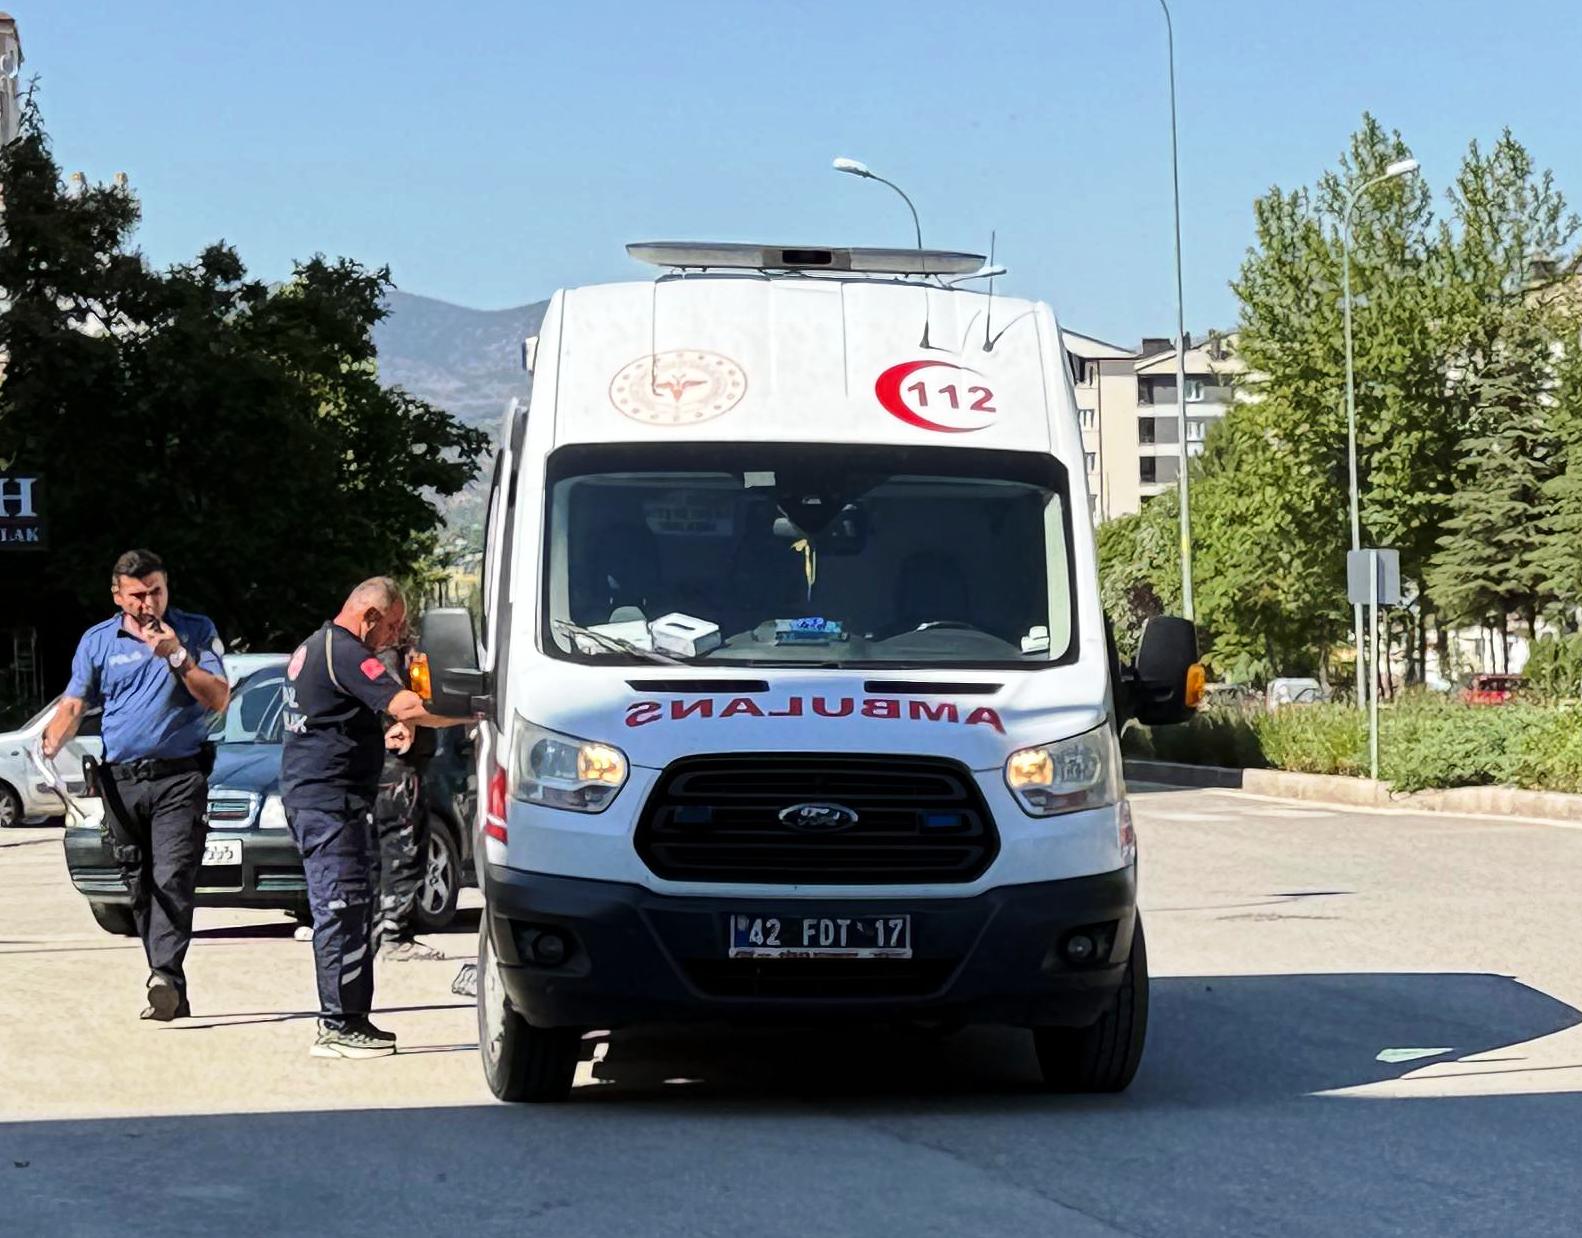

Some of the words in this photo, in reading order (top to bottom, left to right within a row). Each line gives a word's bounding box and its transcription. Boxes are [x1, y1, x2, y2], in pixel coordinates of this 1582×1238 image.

[907, 381, 997, 413] 112
[749, 918, 782, 946] 42
[802, 918, 851, 947] FDT
[875, 918, 904, 947] 17
